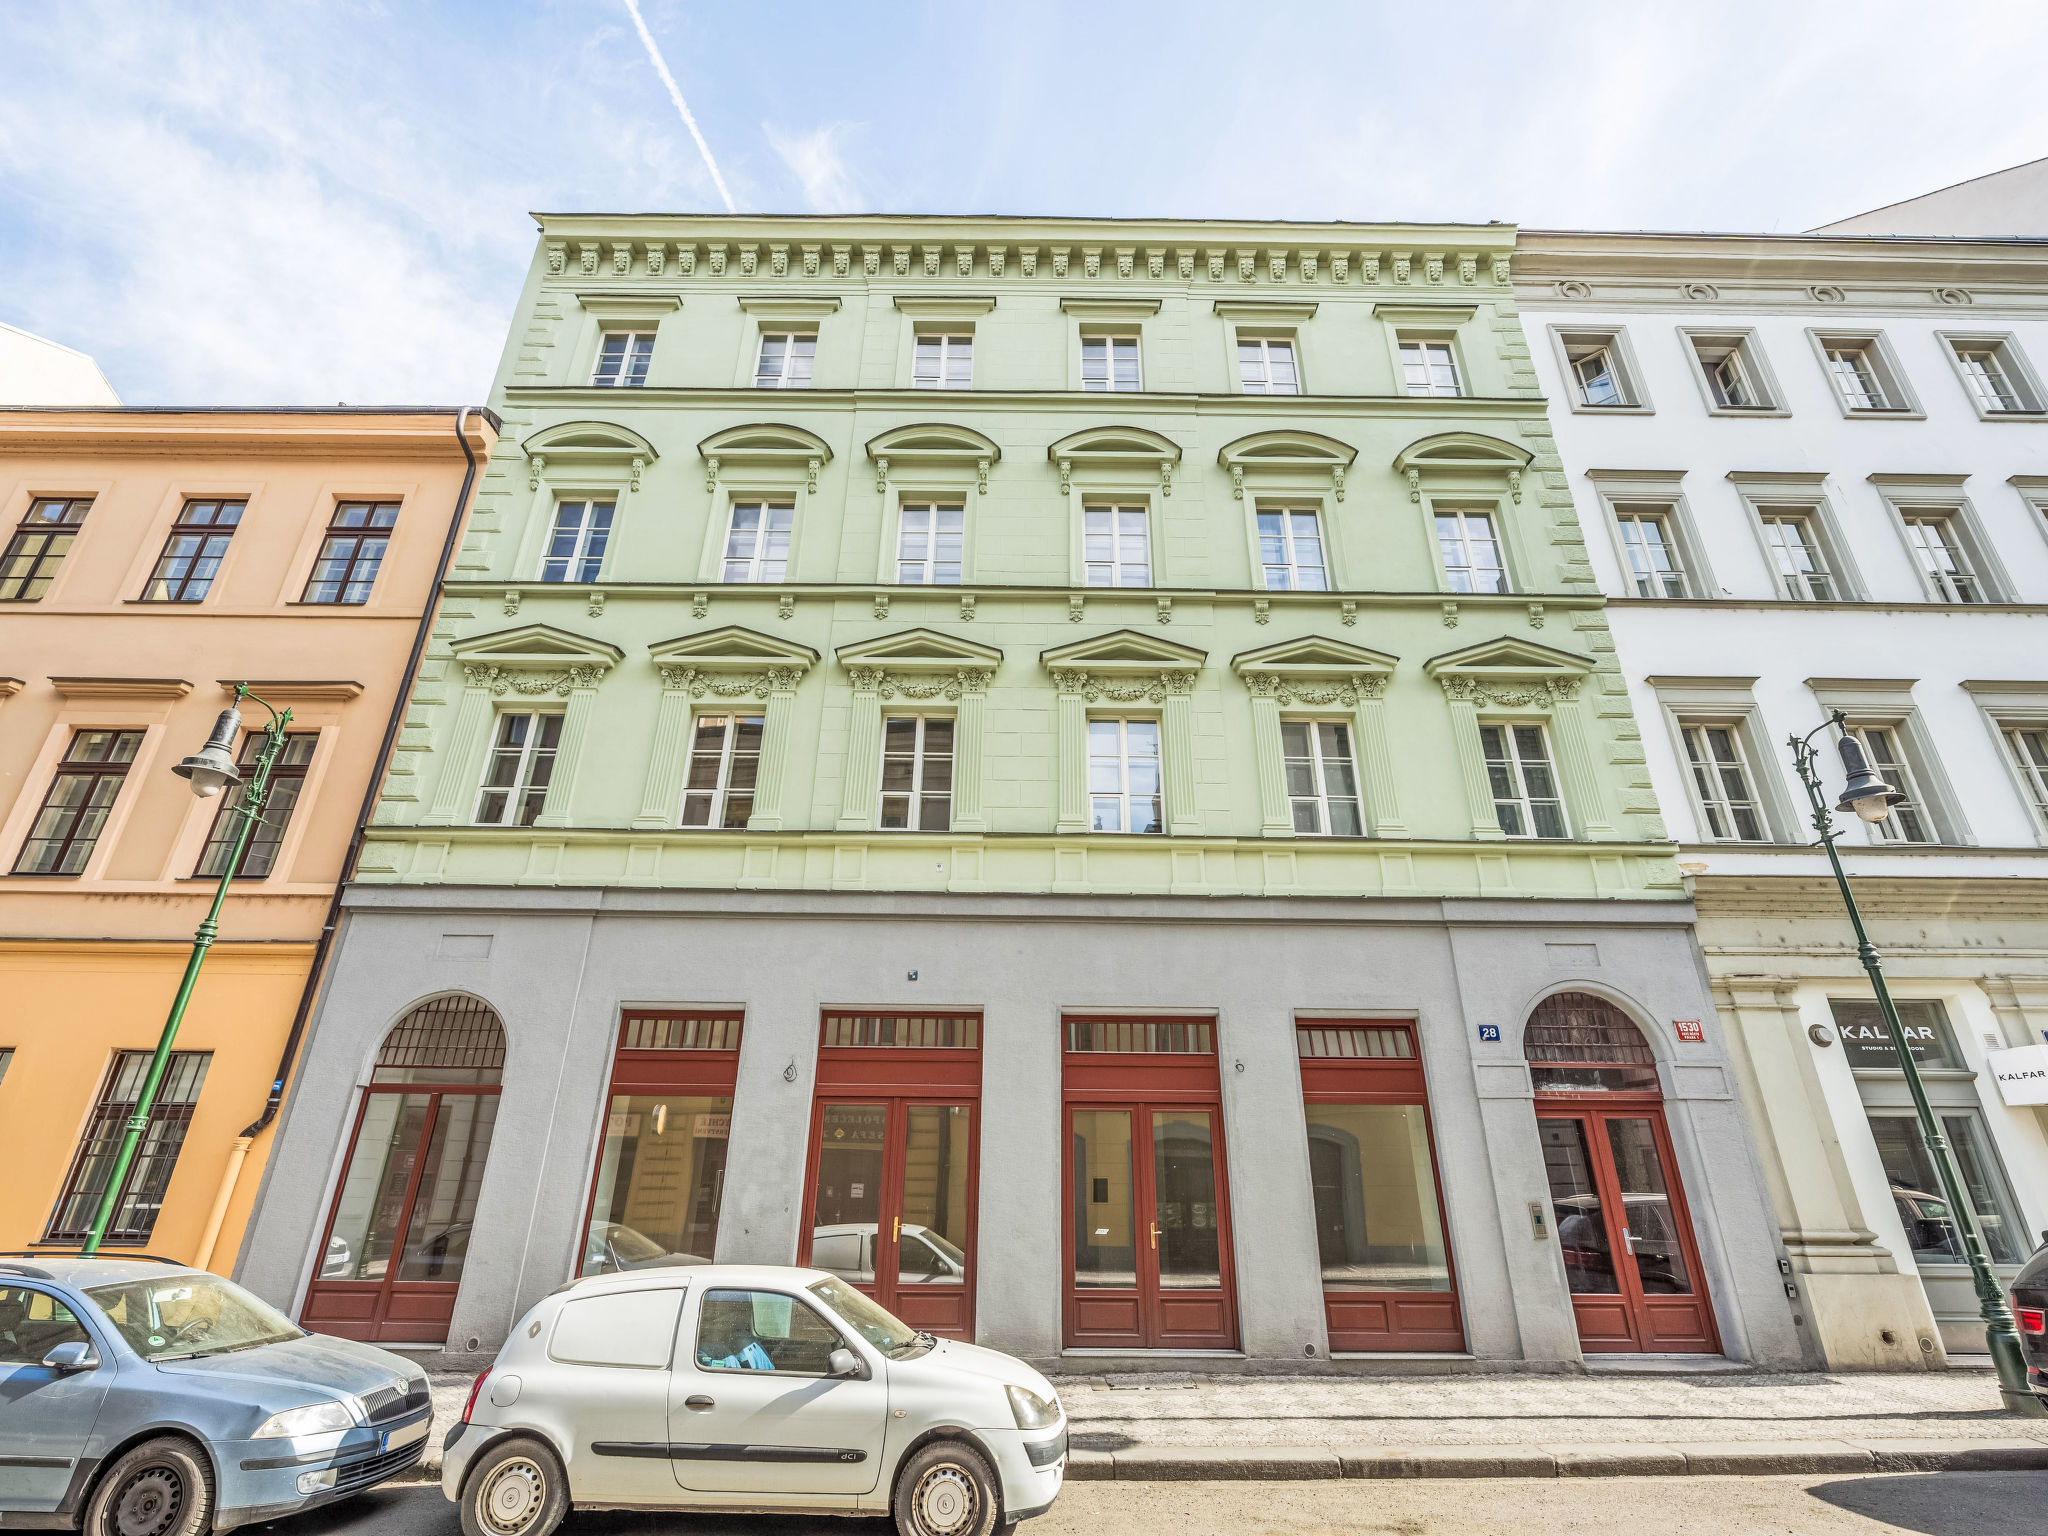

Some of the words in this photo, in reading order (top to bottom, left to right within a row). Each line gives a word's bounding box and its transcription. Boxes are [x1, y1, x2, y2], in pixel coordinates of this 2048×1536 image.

[1482, 1027, 1497, 1038] 28
[1678, 1022, 1699, 1032] 1530
[1839, 1026, 1936, 1040] KALAR
[1998, 1070, 2047, 1082] KALFAR
